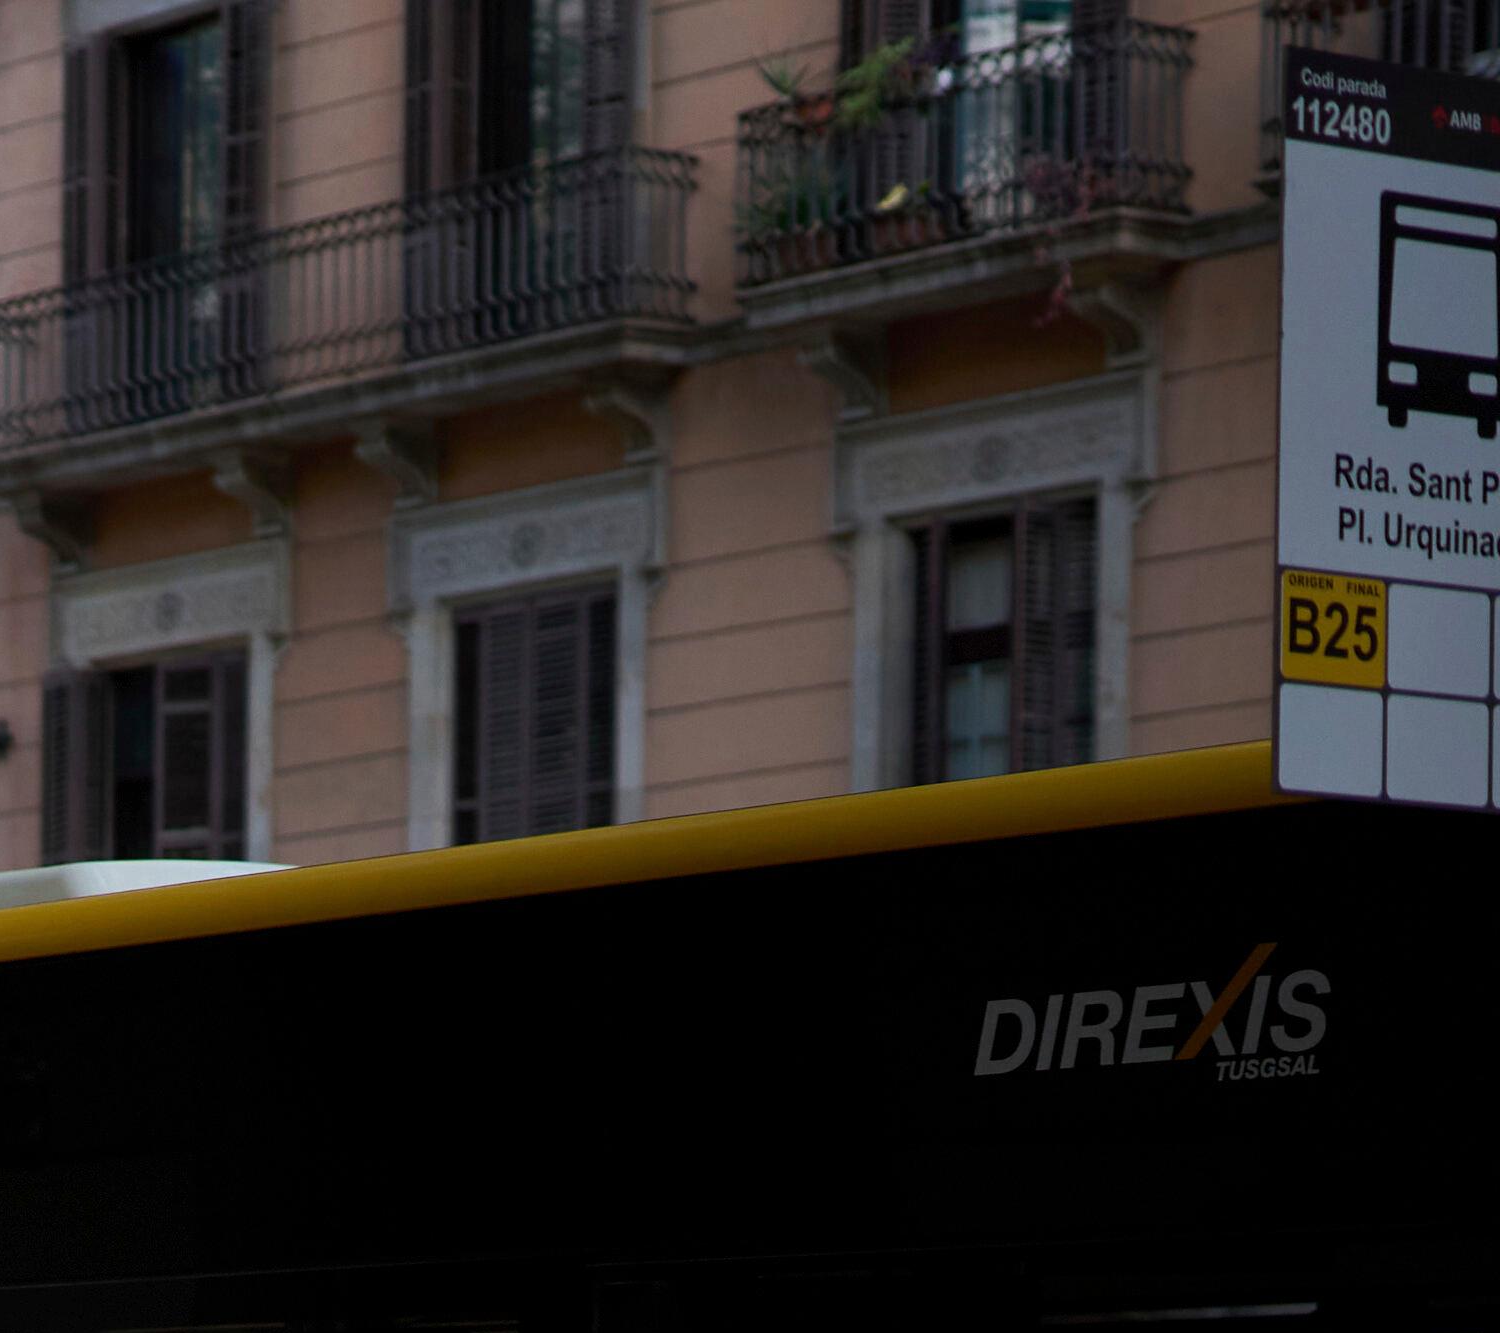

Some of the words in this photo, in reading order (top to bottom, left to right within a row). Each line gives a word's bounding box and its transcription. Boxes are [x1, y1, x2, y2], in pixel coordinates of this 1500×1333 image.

[1301, 66, 1334, 90] Codi
[1338, 75, 1389, 100] parada
[1292, 94, 1392, 146] 112480
[1450, 109, 1482, 132] AMB
[1335, 453, 1398, 494] Rda.
[1408, 463, 1472, 504] Sant
[1339, 507, 1373, 544] Pl.
[1288, 573, 1334, 590] ORIGEN
[1346, 581, 1380, 597] FINAL
[1289, 597, 1378, 661] B25
[974, 942, 1332, 1076] DIREXIS
[1215, 1055, 1321, 1082] TUSGSAL
